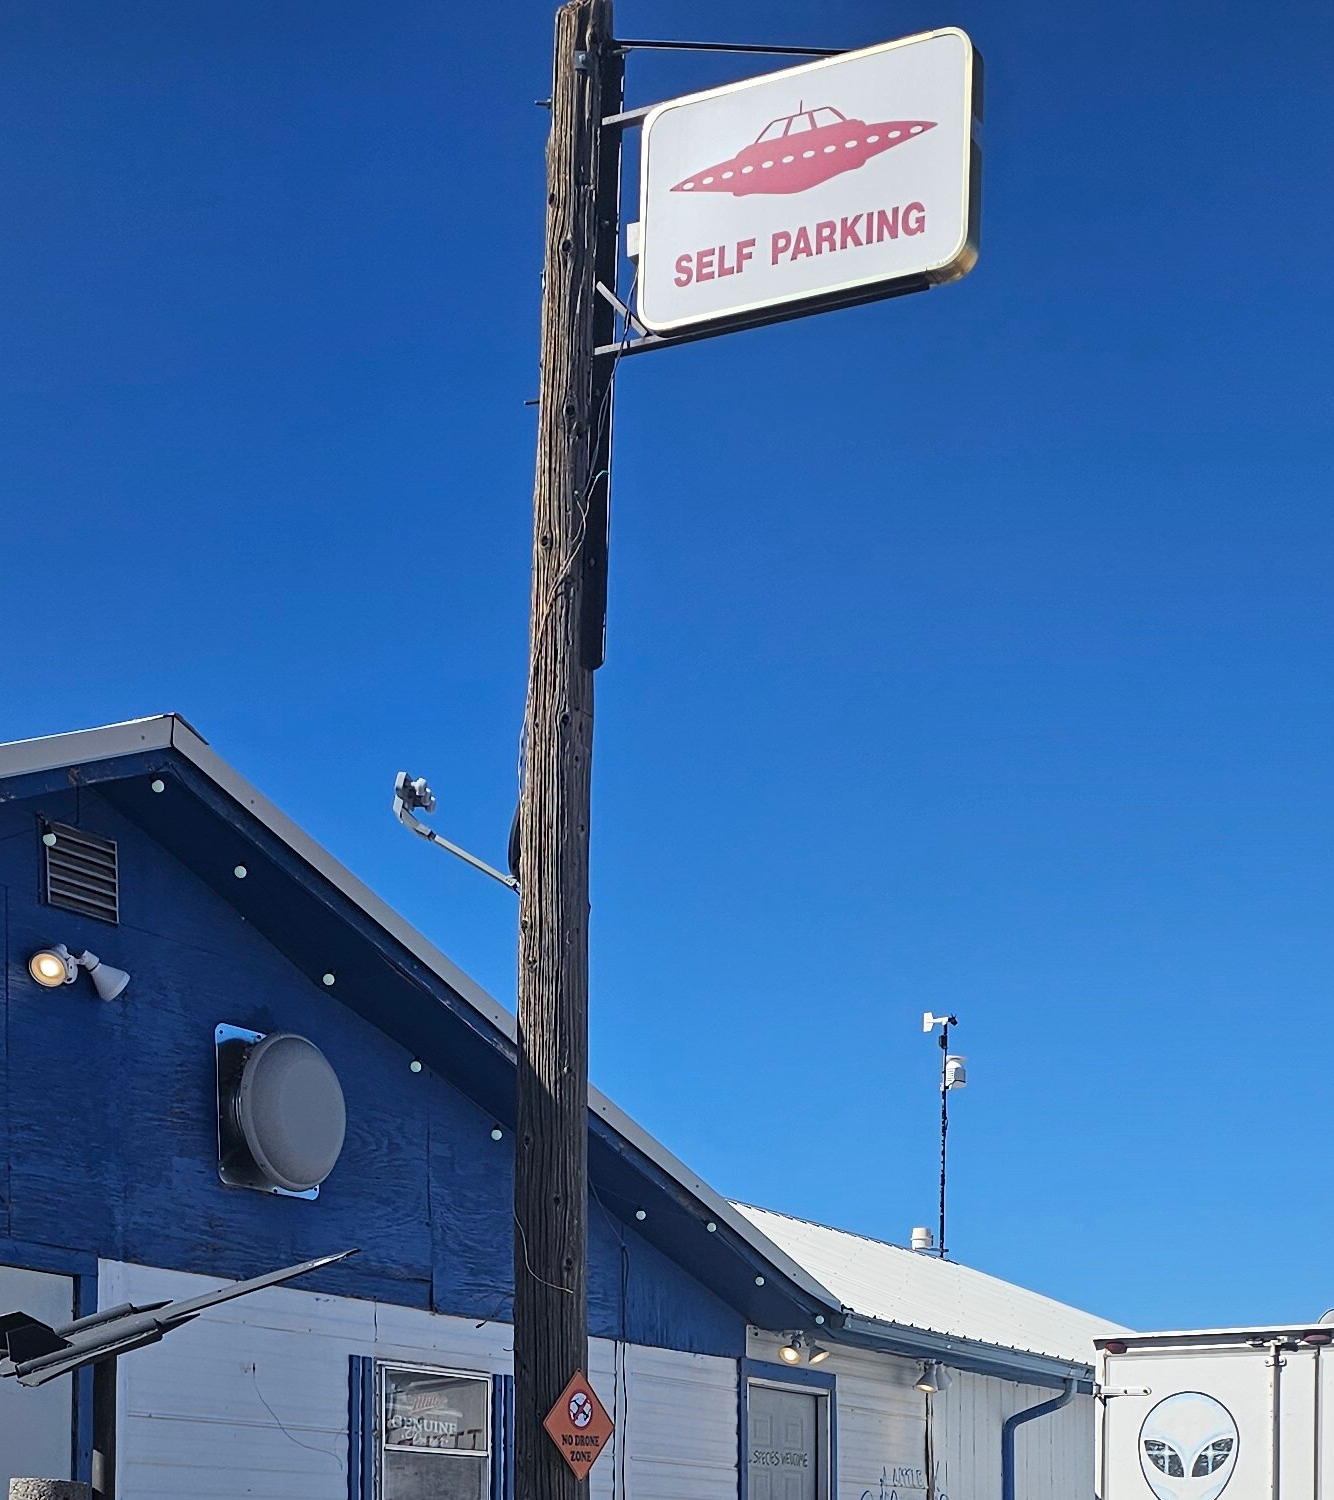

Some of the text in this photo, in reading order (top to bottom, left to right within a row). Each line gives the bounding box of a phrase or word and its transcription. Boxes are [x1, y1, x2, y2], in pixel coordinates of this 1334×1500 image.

[674, 201, 927, 289] SELF PARKING
[561, 1434, 600, 1447] NO DRONE
[569, 1450, 592, 1463] ZONE
